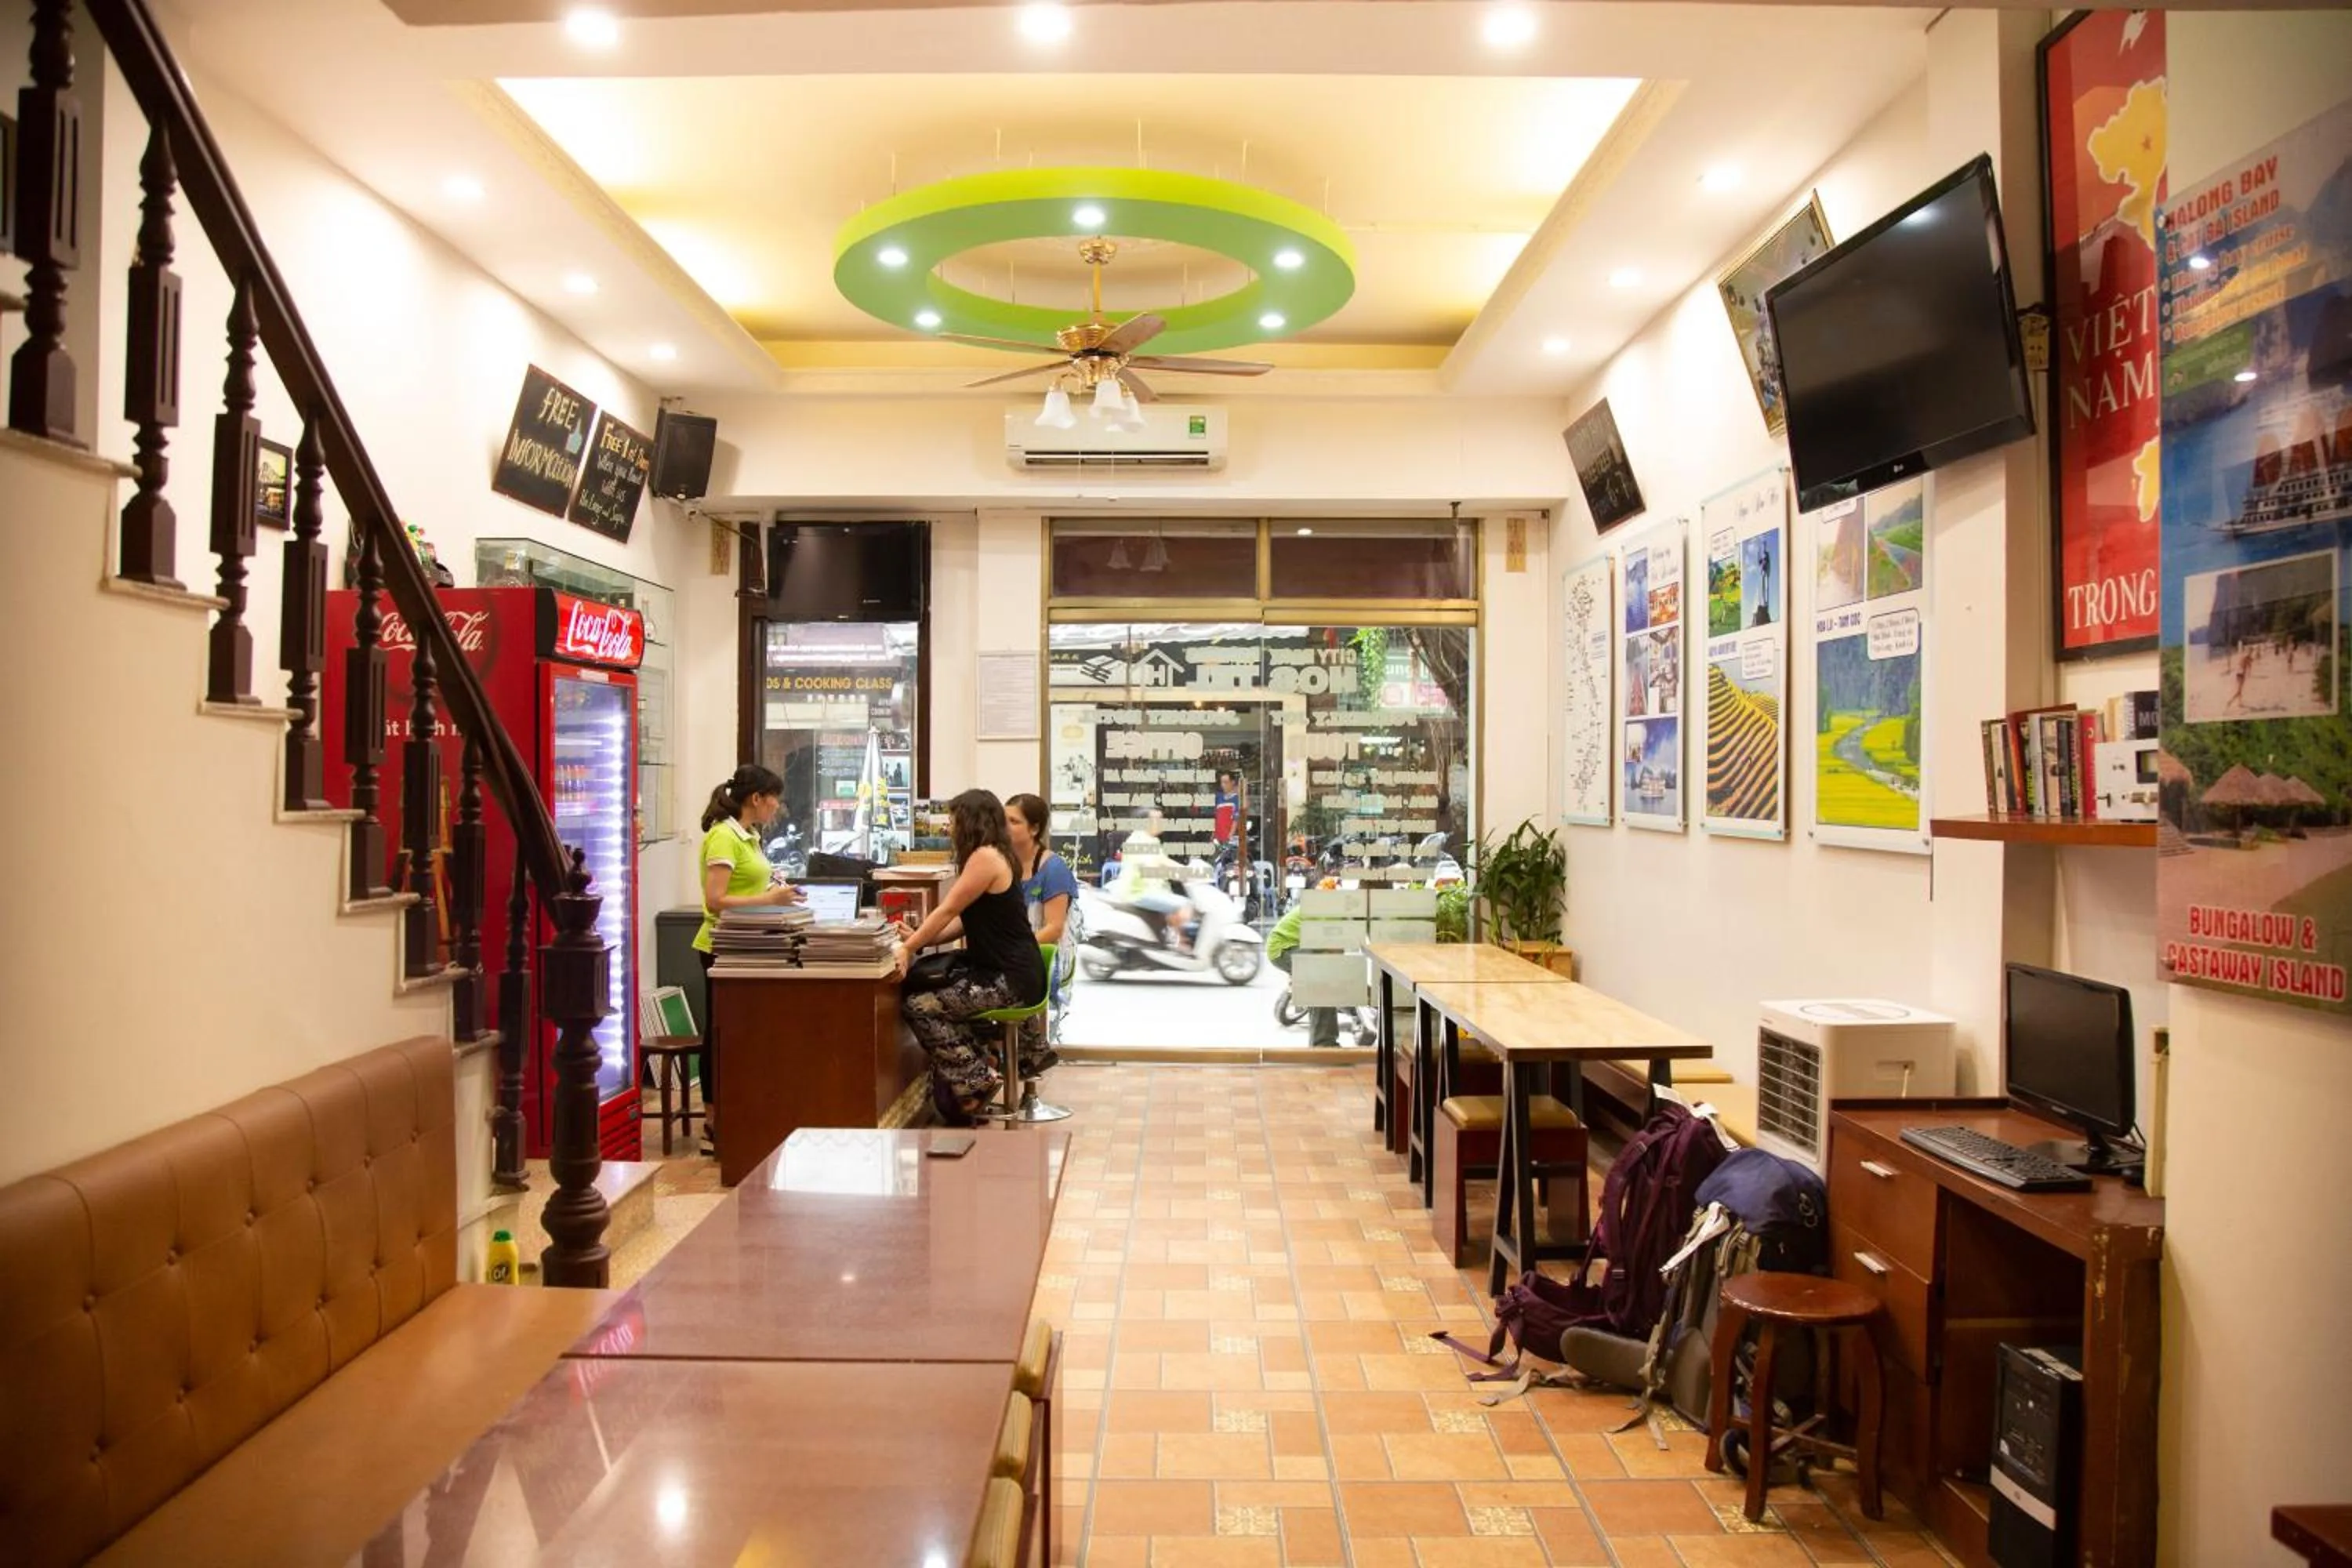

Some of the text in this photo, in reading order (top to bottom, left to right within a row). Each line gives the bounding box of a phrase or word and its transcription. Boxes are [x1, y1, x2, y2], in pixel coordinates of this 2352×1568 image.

[2240, 155, 2279, 196] BAY
[2067, 285, 2155, 364] VIỆT
[539, 387, 580, 430] FREE
[2069, 350, 2155, 430] NAM
[2069, 568, 2156, 630] TRONG
[567, 601, 633, 659] Coca-Cola
[795, 677, 851, 690] COOKING
[855, 677, 893, 690] CLASS
[2189, 906, 2316, 950] BUNGALOW &
[2167, 943, 2345, 1000] CASTAWAY ISLAND
